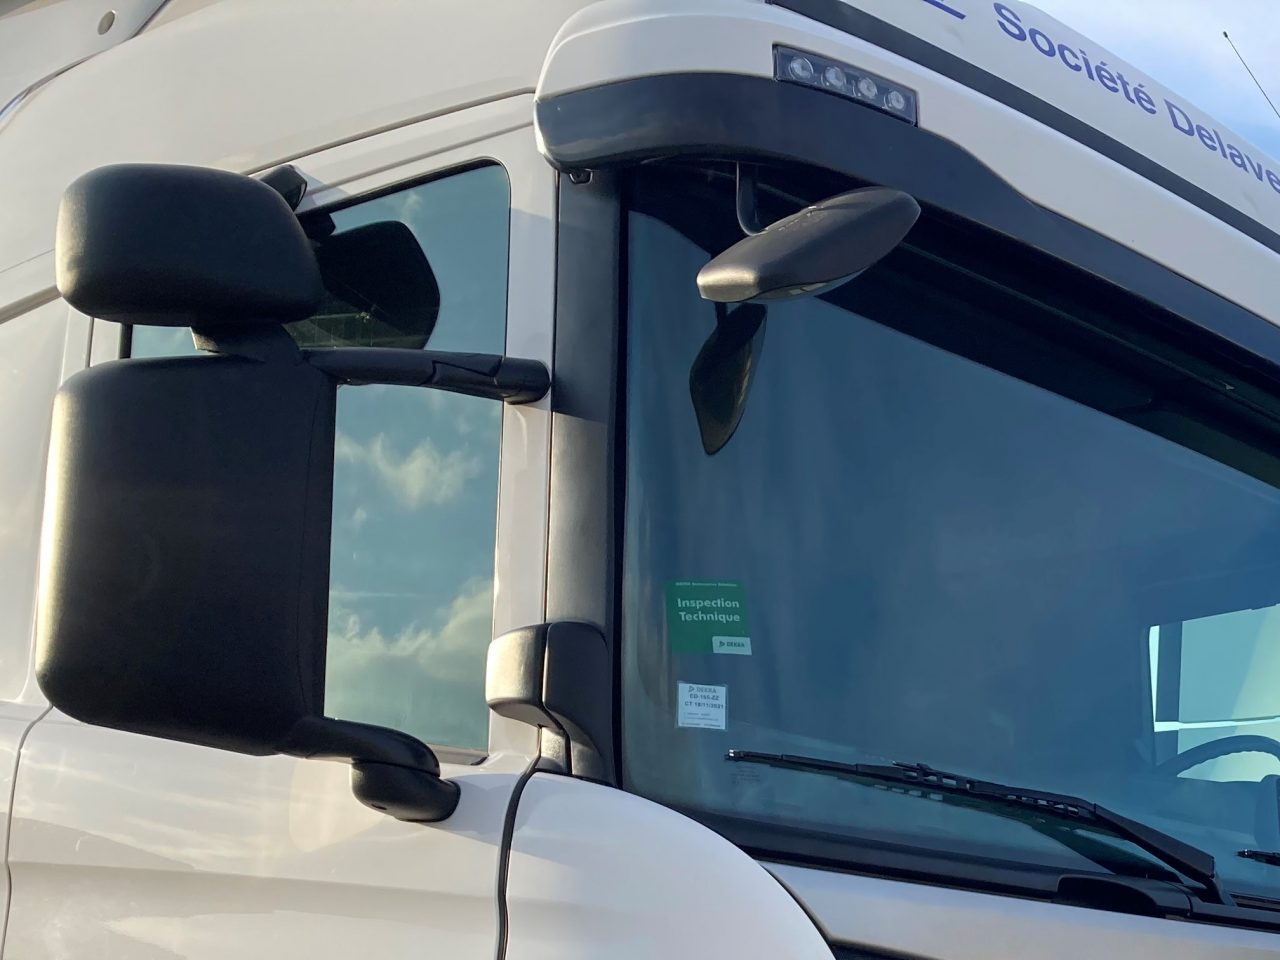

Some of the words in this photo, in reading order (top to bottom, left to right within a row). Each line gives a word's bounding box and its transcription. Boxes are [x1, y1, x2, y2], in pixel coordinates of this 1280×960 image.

[993, 2, 1157, 115] Société
[677, 597, 740, 610] Inspection
[678, 610, 741, 624] Technique
